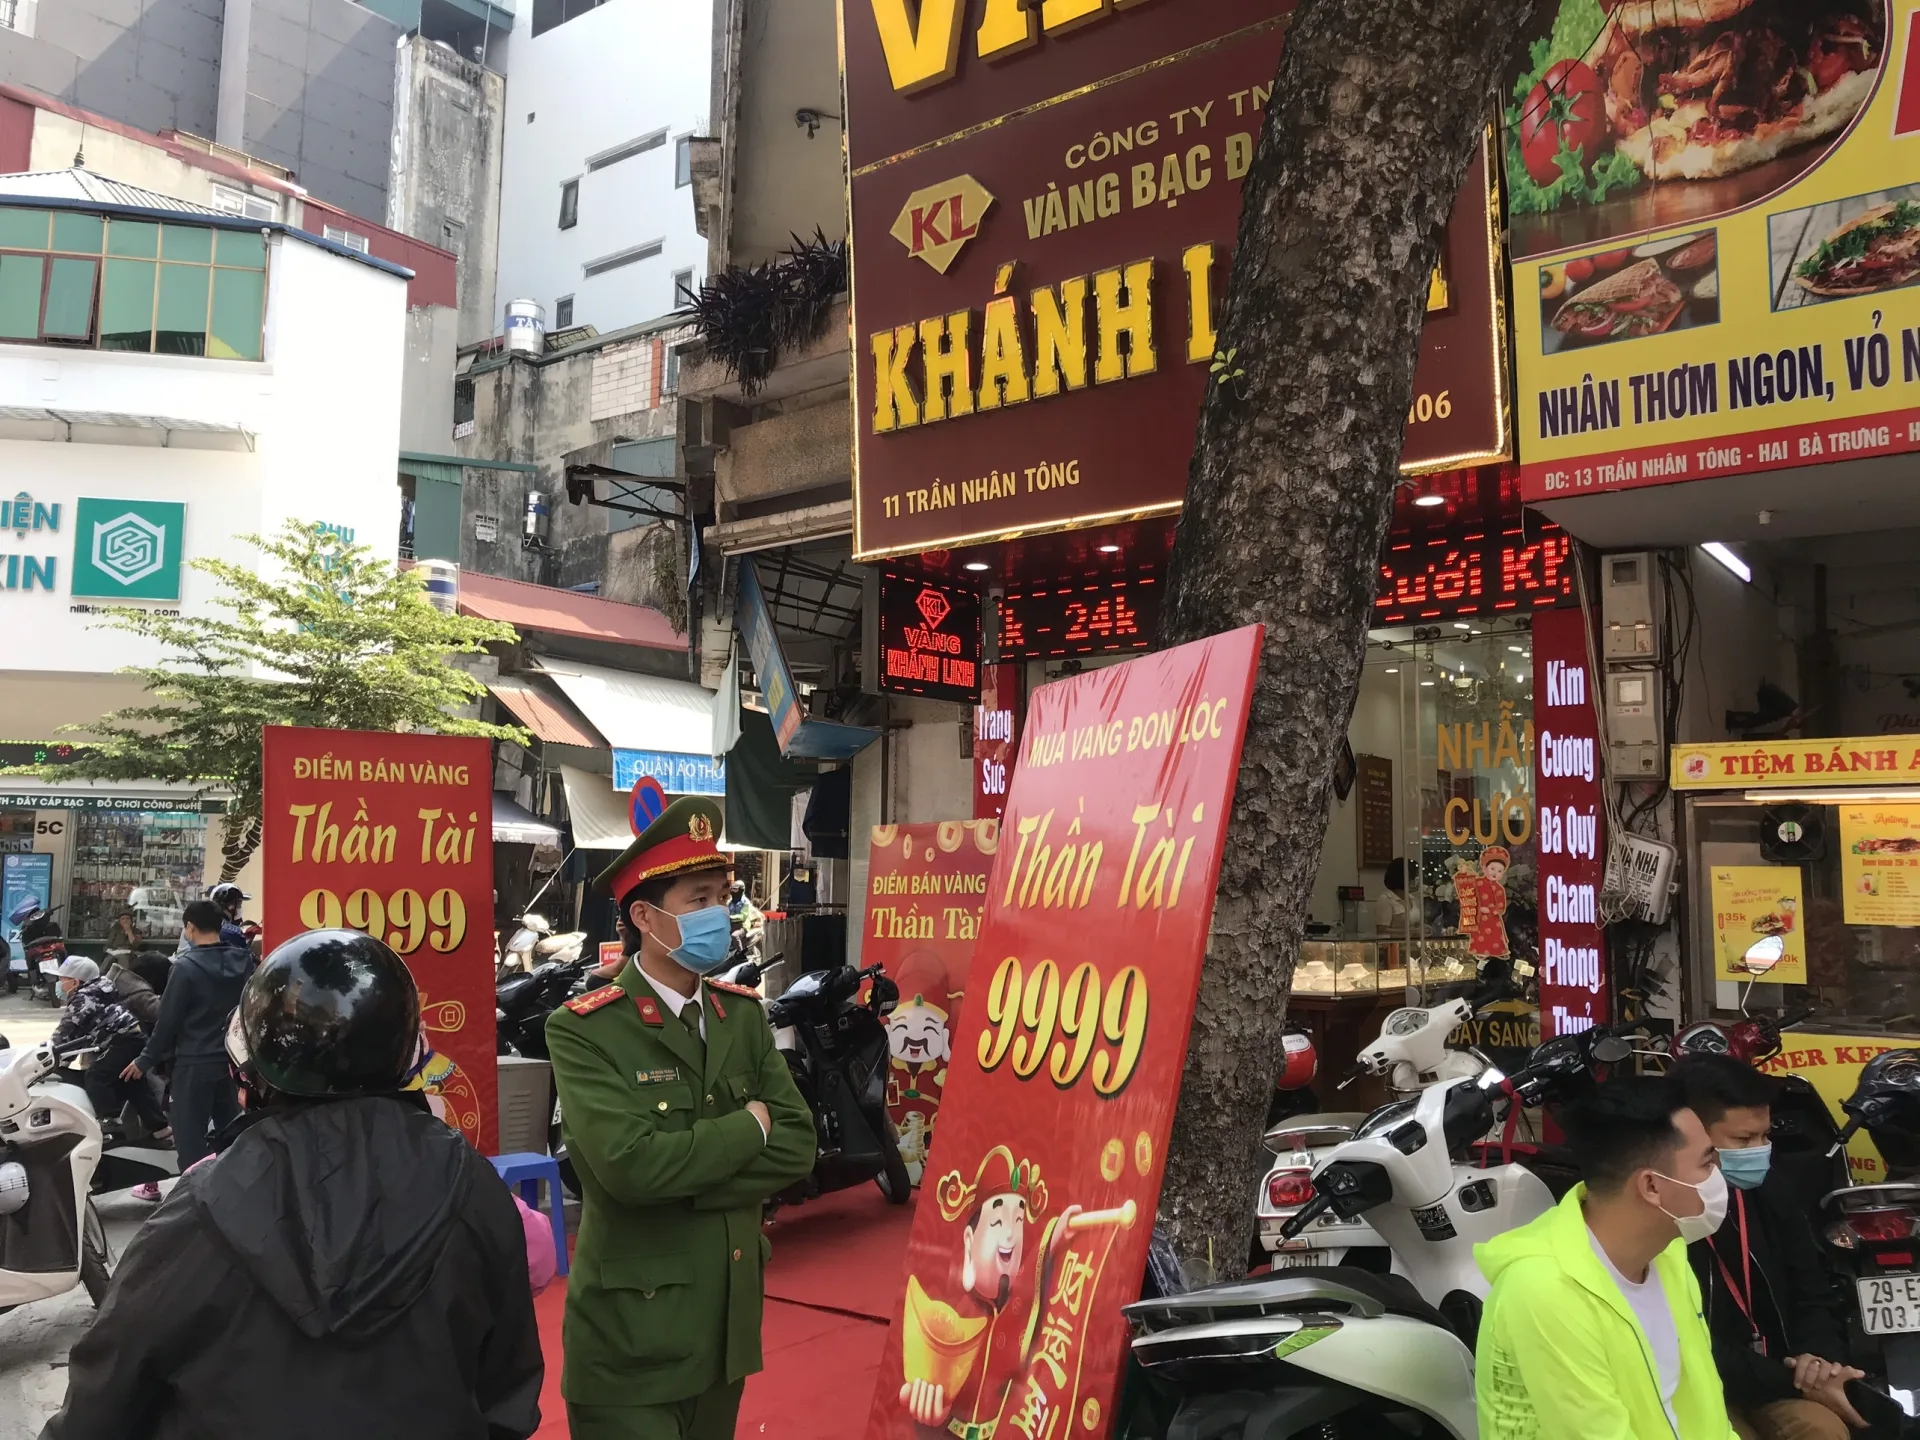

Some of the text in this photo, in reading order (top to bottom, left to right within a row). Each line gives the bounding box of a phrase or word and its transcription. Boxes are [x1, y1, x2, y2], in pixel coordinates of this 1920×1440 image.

[1064, 80, 1274, 170] CÔNG TY TN
[1022, 132, 1254, 241] VÀNG BẠC Đ
[908, 193, 979, 257] KL
[869, 256, 1158, 436] KHÁNH
[1538, 373, 1620, 439] NHÂN
[1628, 361, 1717, 425] THƠM
[1727, 343, 1835, 411] NGON,
[1844, 309, 1890, 391] VỎ
[1545, 472, 1570, 491] ĐC:
[1574, 467, 1592, 488] 13
[1596, 455, 1638, 485] TRẦN
[1641, 452, 1687, 479] NHÂN
[1697, 445, 1741, 470] TÔNG
[1758, 441, 1788, 464] HAI
[1799, 433, 1824, 457] BÀ
[1828, 426, 1890, 453] TRƯNG
[882, 457, 1081, 519] 11 TRẦN NHÂN TÔNG
[0, 554, 57, 592] IN
[903, 622, 962, 655] VÀNG
[1065, 596, 1137, 640] 24k
[887, 648, 940, 683] KHÁNH
[942, 658, 975, 688] LINH
[1546, 660, 1585, 706] Kim
[978, 704, 1012, 744] Trang
[293, 751, 469, 786] ĐIỂM BÁN VÀNG
[1027, 731, 1067, 769] MUA
[1541, 730, 1594, 783] Cương
[1720, 748, 1795, 780] TIỆM
[1804, 745, 1898, 773] BÁNH
[982, 754, 1006, 795] Sức
[17, 796, 37, 806] DÂY
[40, 797, 61, 806] CÁP
[143, 798, 173, 810] CÔNG
[1443, 783, 1532, 847] CƯỚ
[36, 821, 64, 835] 5C
[289, 797, 478, 865] Thần Tài
[1541, 805, 1596, 860] Đá Quý
[1002, 797, 1205, 911] Thần Tài
[872, 870, 986, 895] ĐIỂM BÁN VÀNG
[300, 888, 467, 953] 9999
[872, 902, 984, 941] Thần Tài
[1545, 938, 1599, 995] Phong
[977, 956, 1149, 1095] 9999
[1751, 1049, 1828, 1074] ONER
